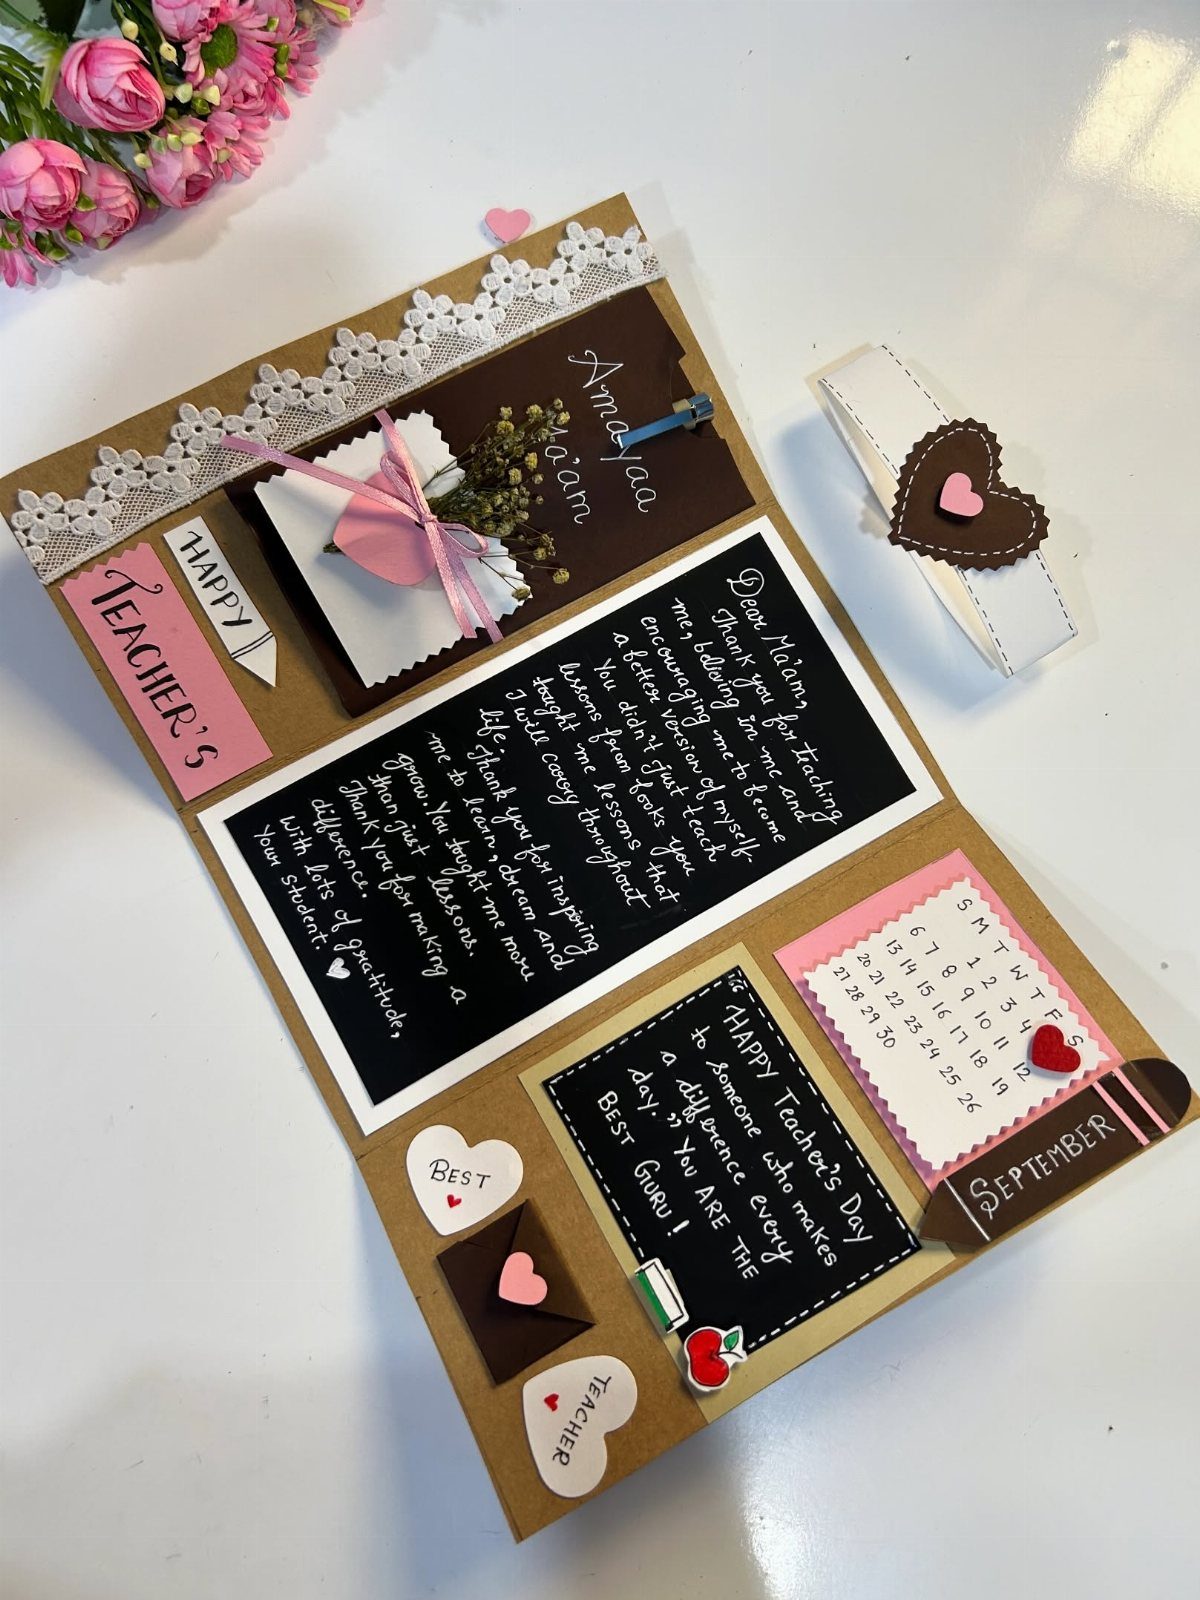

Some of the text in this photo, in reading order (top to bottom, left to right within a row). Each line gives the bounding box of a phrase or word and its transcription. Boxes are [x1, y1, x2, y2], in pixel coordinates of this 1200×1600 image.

[566, 349, 657, 513] Amayaa
[178, 530, 253, 627] HAPPY
[725, 567, 808, 710] Dear Ma'am,
[90, 569, 219, 769] TEACHER'S
[475, 708, 512, 755] life.
[504, 688, 528, 701] I
[513, 707, 550, 747] will
[612, 632, 630, 649] a
[622, 649, 661, 704] better
[660, 708, 703, 774] version
[694, 777, 726, 801] of
[640, 616, 786, 844] encouraging me to become
[693, 641, 740, 710] believing
[736, 714, 759, 742] in
[759, 745, 783, 779] me
[777, 784, 815, 825] and
[710, 607, 843, 826] Thank you for teaching
[557, 662, 695, 878] lessons from books you
[573, 742, 596, 774] me
[592, 782, 642, 851] lessons
[644, 861, 680, 903] that
[592, 657, 726, 863] You didn't just teach
[252, 824, 281, 867] Your
[303, 864, 336, 901] lots
[310, 799, 368, 899] difference.
[330, 909, 363, 933] of
[338, 779, 467, 1006] Thank you for making a
[366, 773, 478, 957] than just lessons.
[424, 800, 451, 835] You
[481, 896, 505, 930] me
[500, 935, 535, 983] more
[427, 732, 451, 764] me
[446, 768, 468, 787] to
[498, 864, 536, 921] dream
[532, 928, 575, 971] and
[466, 744, 600, 956] Thank you for inspiring
[577, 807, 652, 909] throughout
[332, 938, 407, 1038] gratitude,
[832, 966, 896, 1049] 27 28 29 30
[856, 952, 982, 1113] 20 21 22 23 24 25 26
[885, 939, 1009, 1096] 13 14 15 16 17 18 19
[909, 926, 1032, 1083] 6 7 8 9 10 11 12
[956, 898, 1084, 1047] S M T W T F S
[966, 956, 1032, 1034] 1 2 3 4
[428, 1158, 492, 1190] BEST
[596, 1090, 635, 1145] BEST
[659, 1050, 794, 1264] a difference every
[690, 1025, 837, 1267] to someone who makes
[773, 1086, 842, 1192] Teacher's
[838, 1192, 873, 1243] Day
[968, 1113, 1117, 1221] SEPTEMBER
[694, 1185, 731, 1230] ARE
[731, 1234, 760, 1280] THE
[551, 1375, 613, 1467] TEACHER
